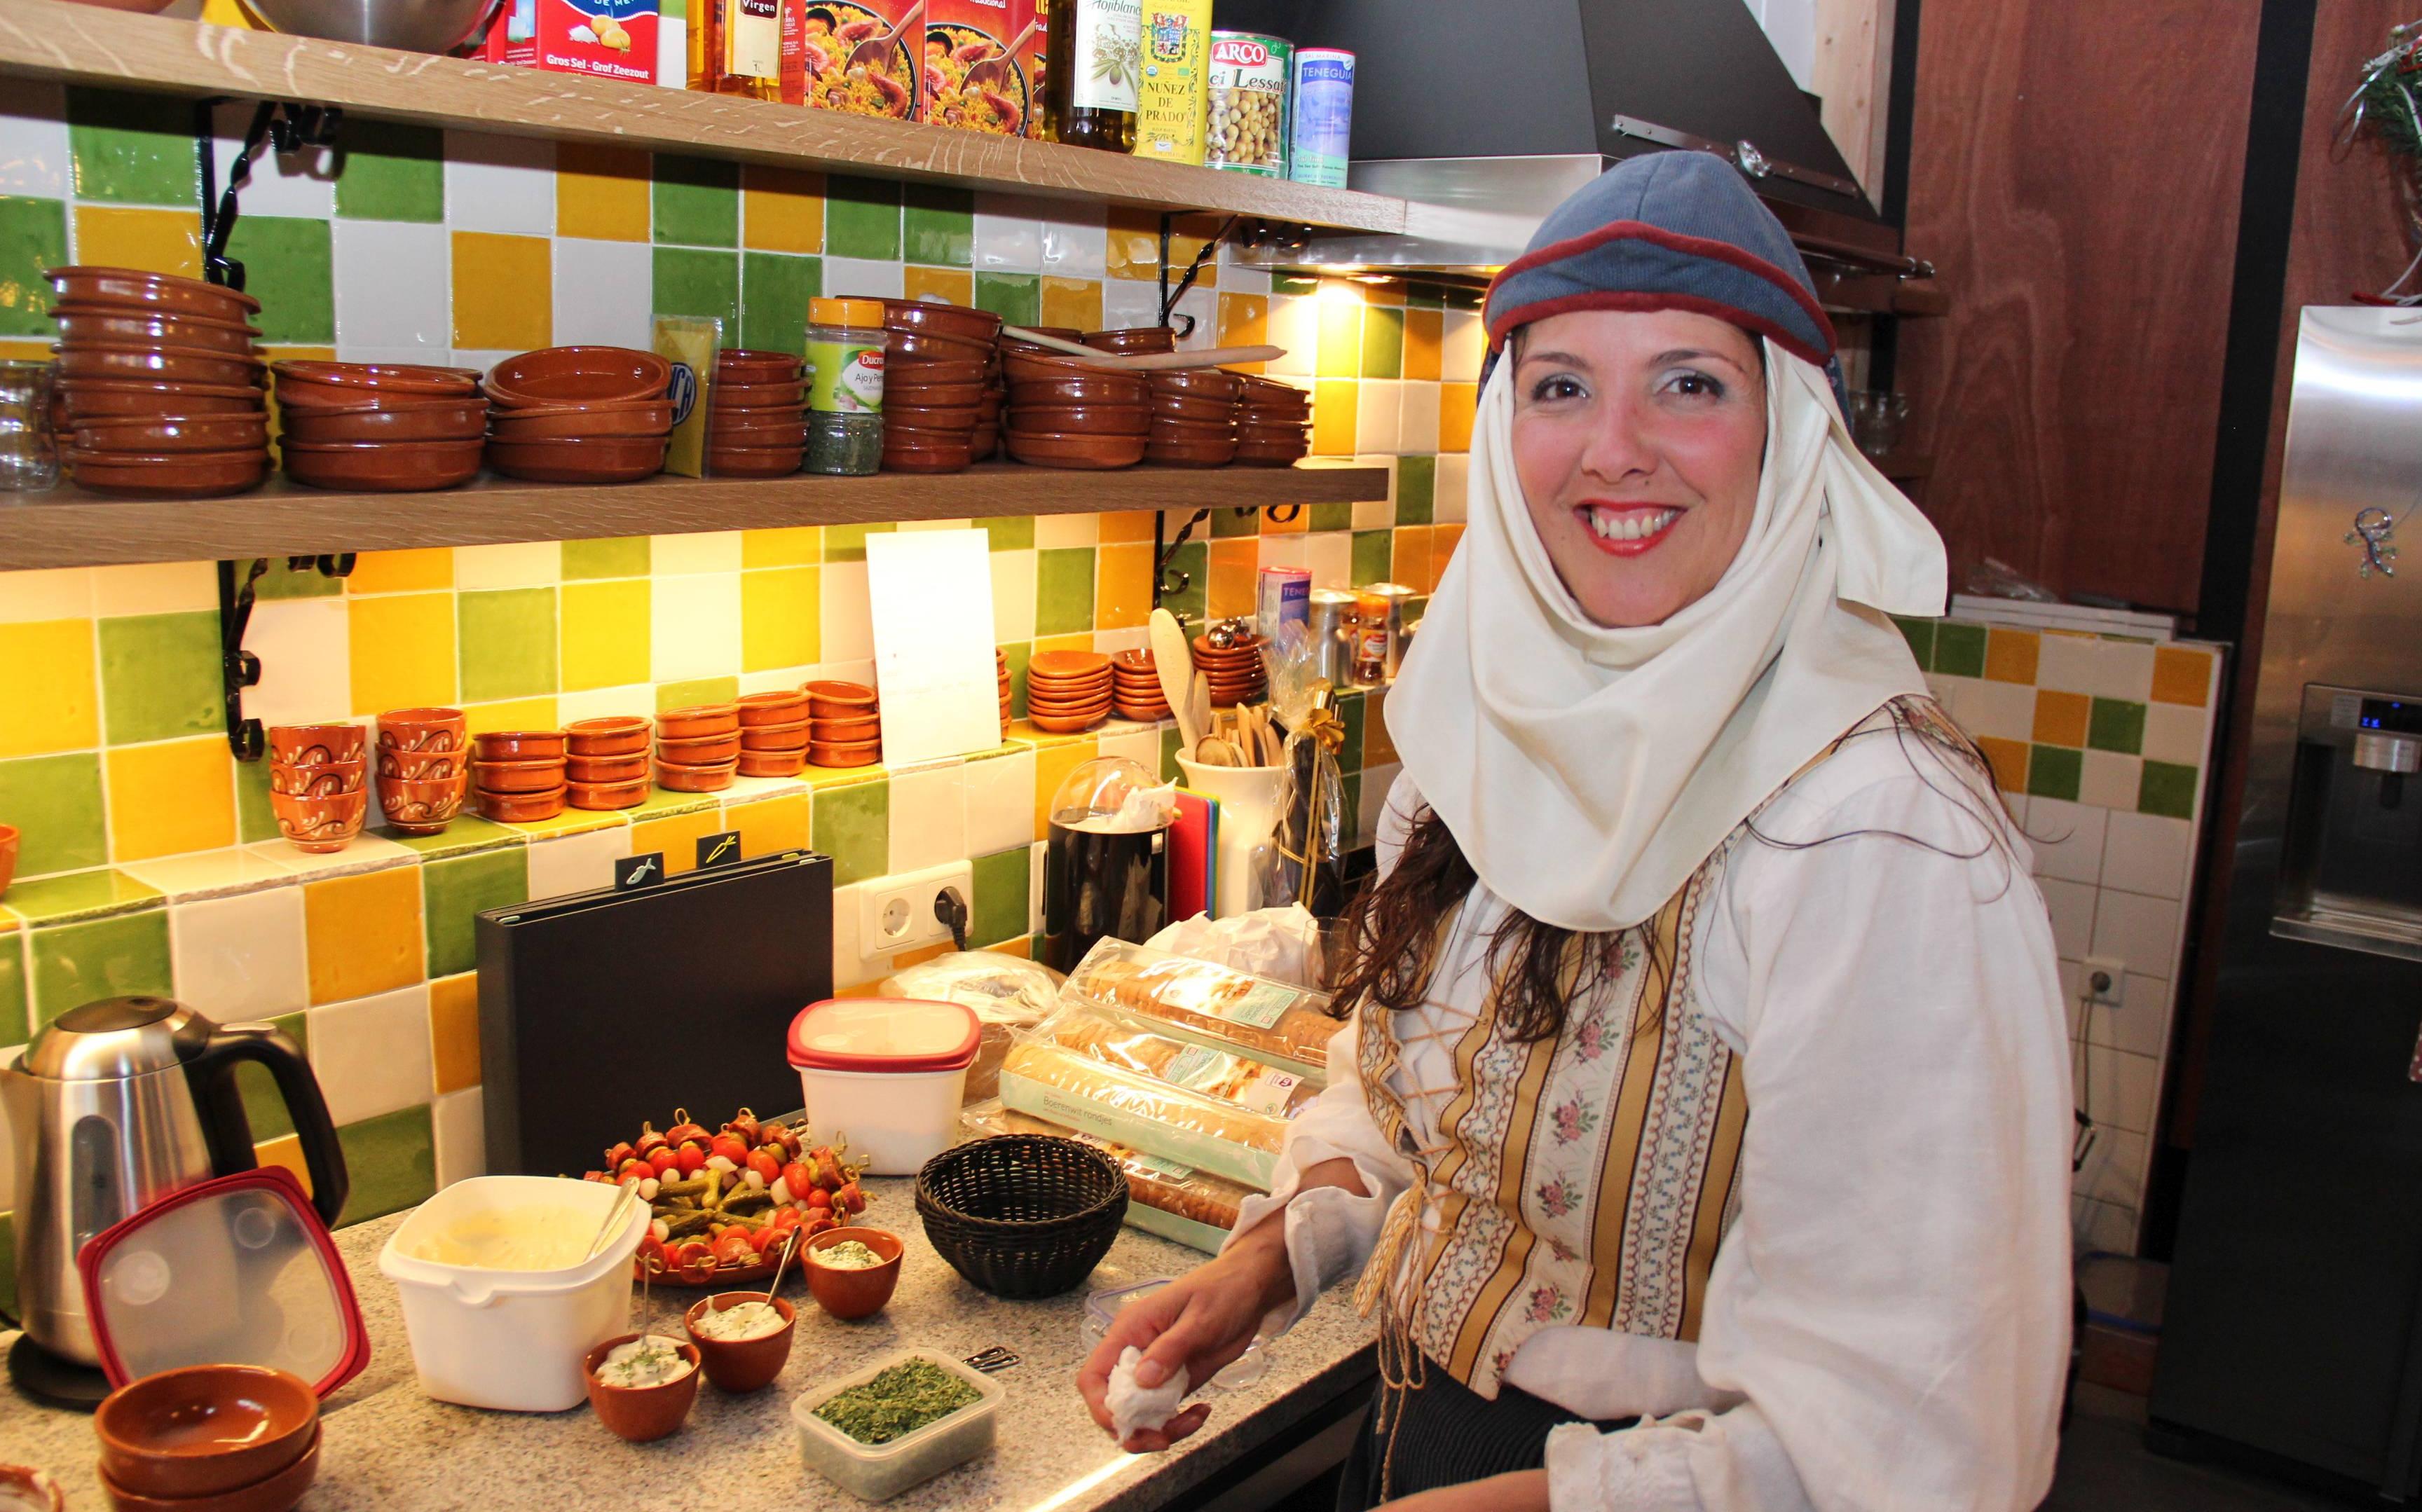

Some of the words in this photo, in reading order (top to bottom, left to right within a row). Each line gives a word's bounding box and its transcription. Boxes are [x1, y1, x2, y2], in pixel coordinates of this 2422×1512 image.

[743, 0, 775, 13] Virgen
[1215, 43, 1265, 64] ARCO
[546, 54, 570, 66] Gros
[570, 57, 586, 69] Sel
[592, 61, 613, 72] Grof
[613, 65, 649, 79] Zeezout
[1147, 81, 1185, 96] NUÑEZ
[1158, 97, 1173, 108] DE
[1146, 110, 1184, 123] PRADO
[855, 373, 868, 384] Ajo
[1044, 1096, 1082, 1117] Boerenwit
[1083, 1111, 1112, 1127] rondjes
